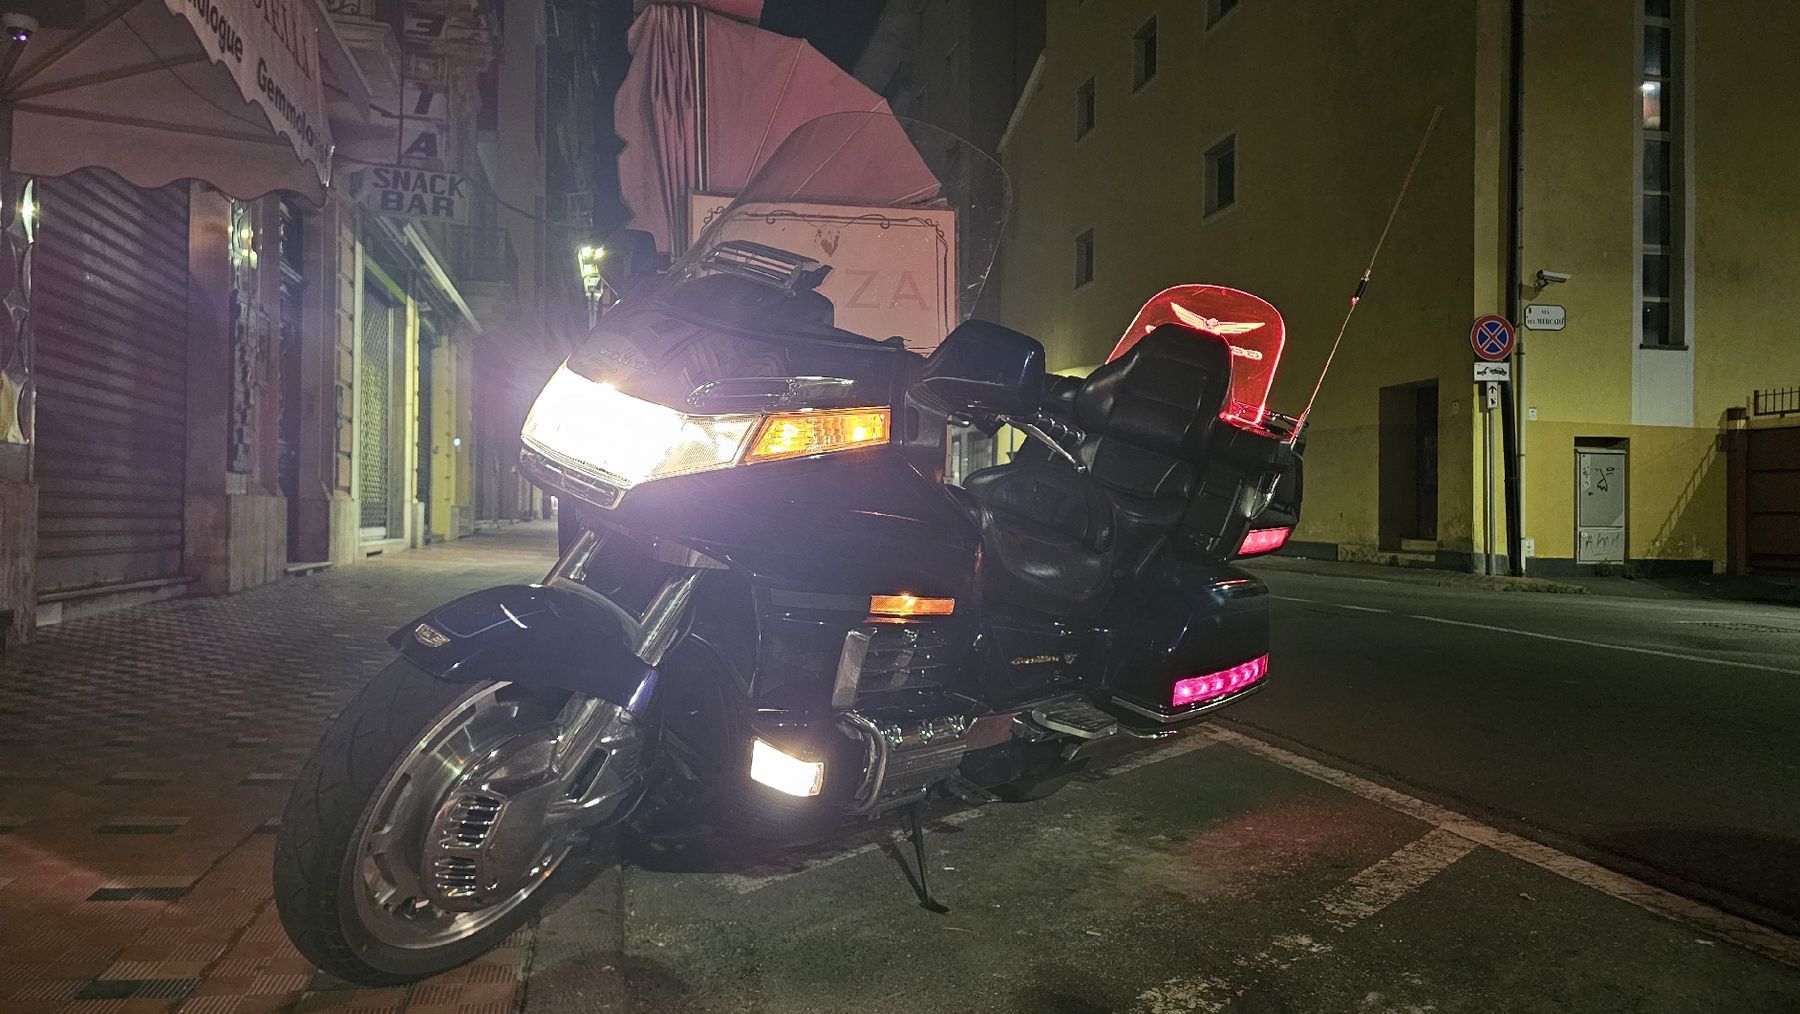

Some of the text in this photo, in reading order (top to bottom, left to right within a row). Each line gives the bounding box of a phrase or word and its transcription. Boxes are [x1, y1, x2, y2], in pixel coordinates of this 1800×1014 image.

[188, 0, 320, 158] ologue Gemmolo
[372, 167, 467, 198] SNACK
[380, 190, 455, 217] BAR
[844, 268, 934, 311] ZA
